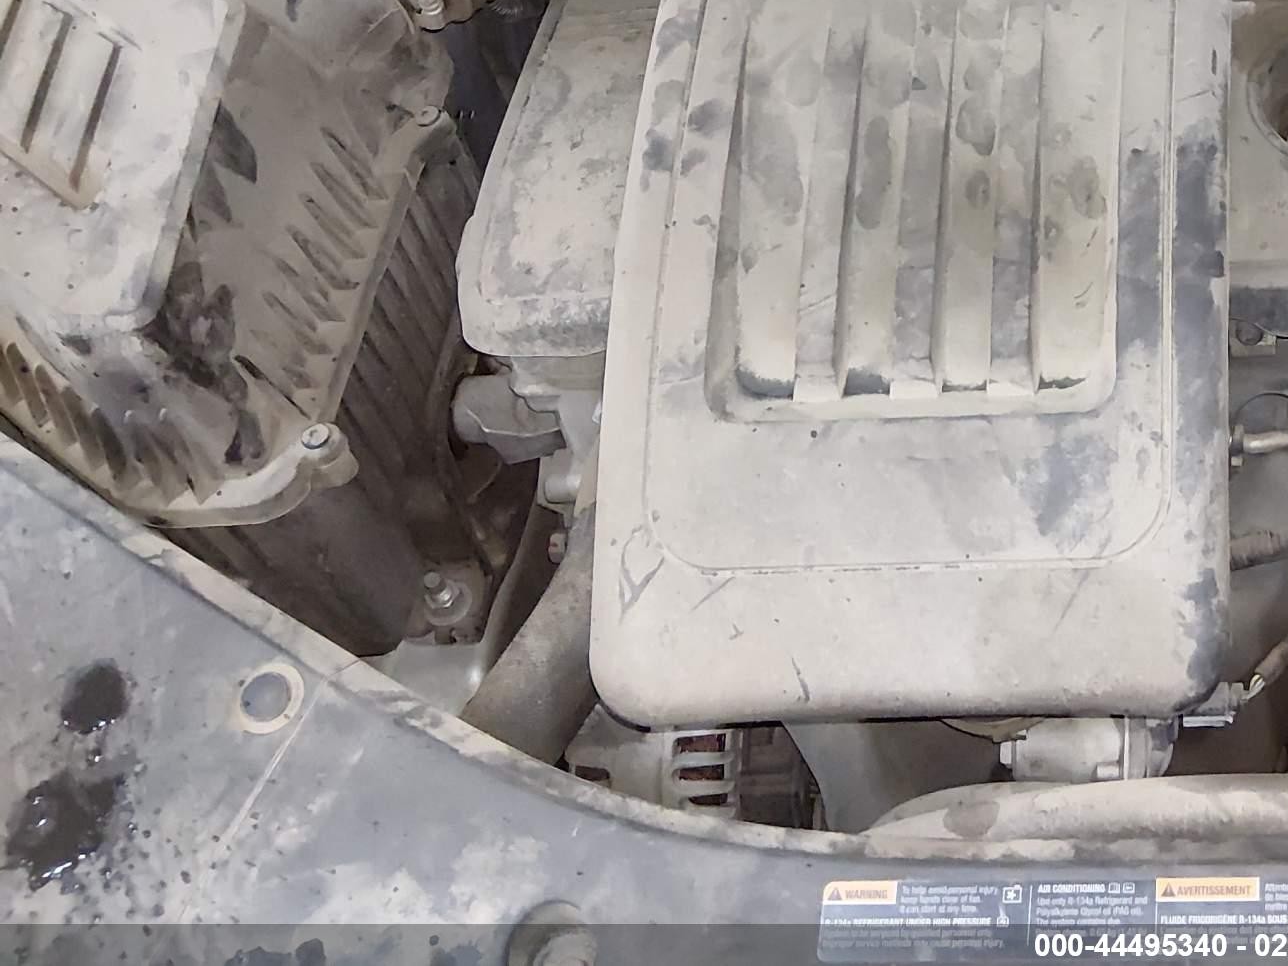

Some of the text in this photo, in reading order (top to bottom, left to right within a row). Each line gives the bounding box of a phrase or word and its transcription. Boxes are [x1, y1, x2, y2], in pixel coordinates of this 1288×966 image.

[1038, 883, 1105, 893] AIR CONDITIONING
[1176, 885, 1251, 896] AVERTISSEMENT
[845, 889, 888, 899] WARNING
[1239, 915, 1266, 924] R-134a
[1267, 914, 1287, 924] SOUS
